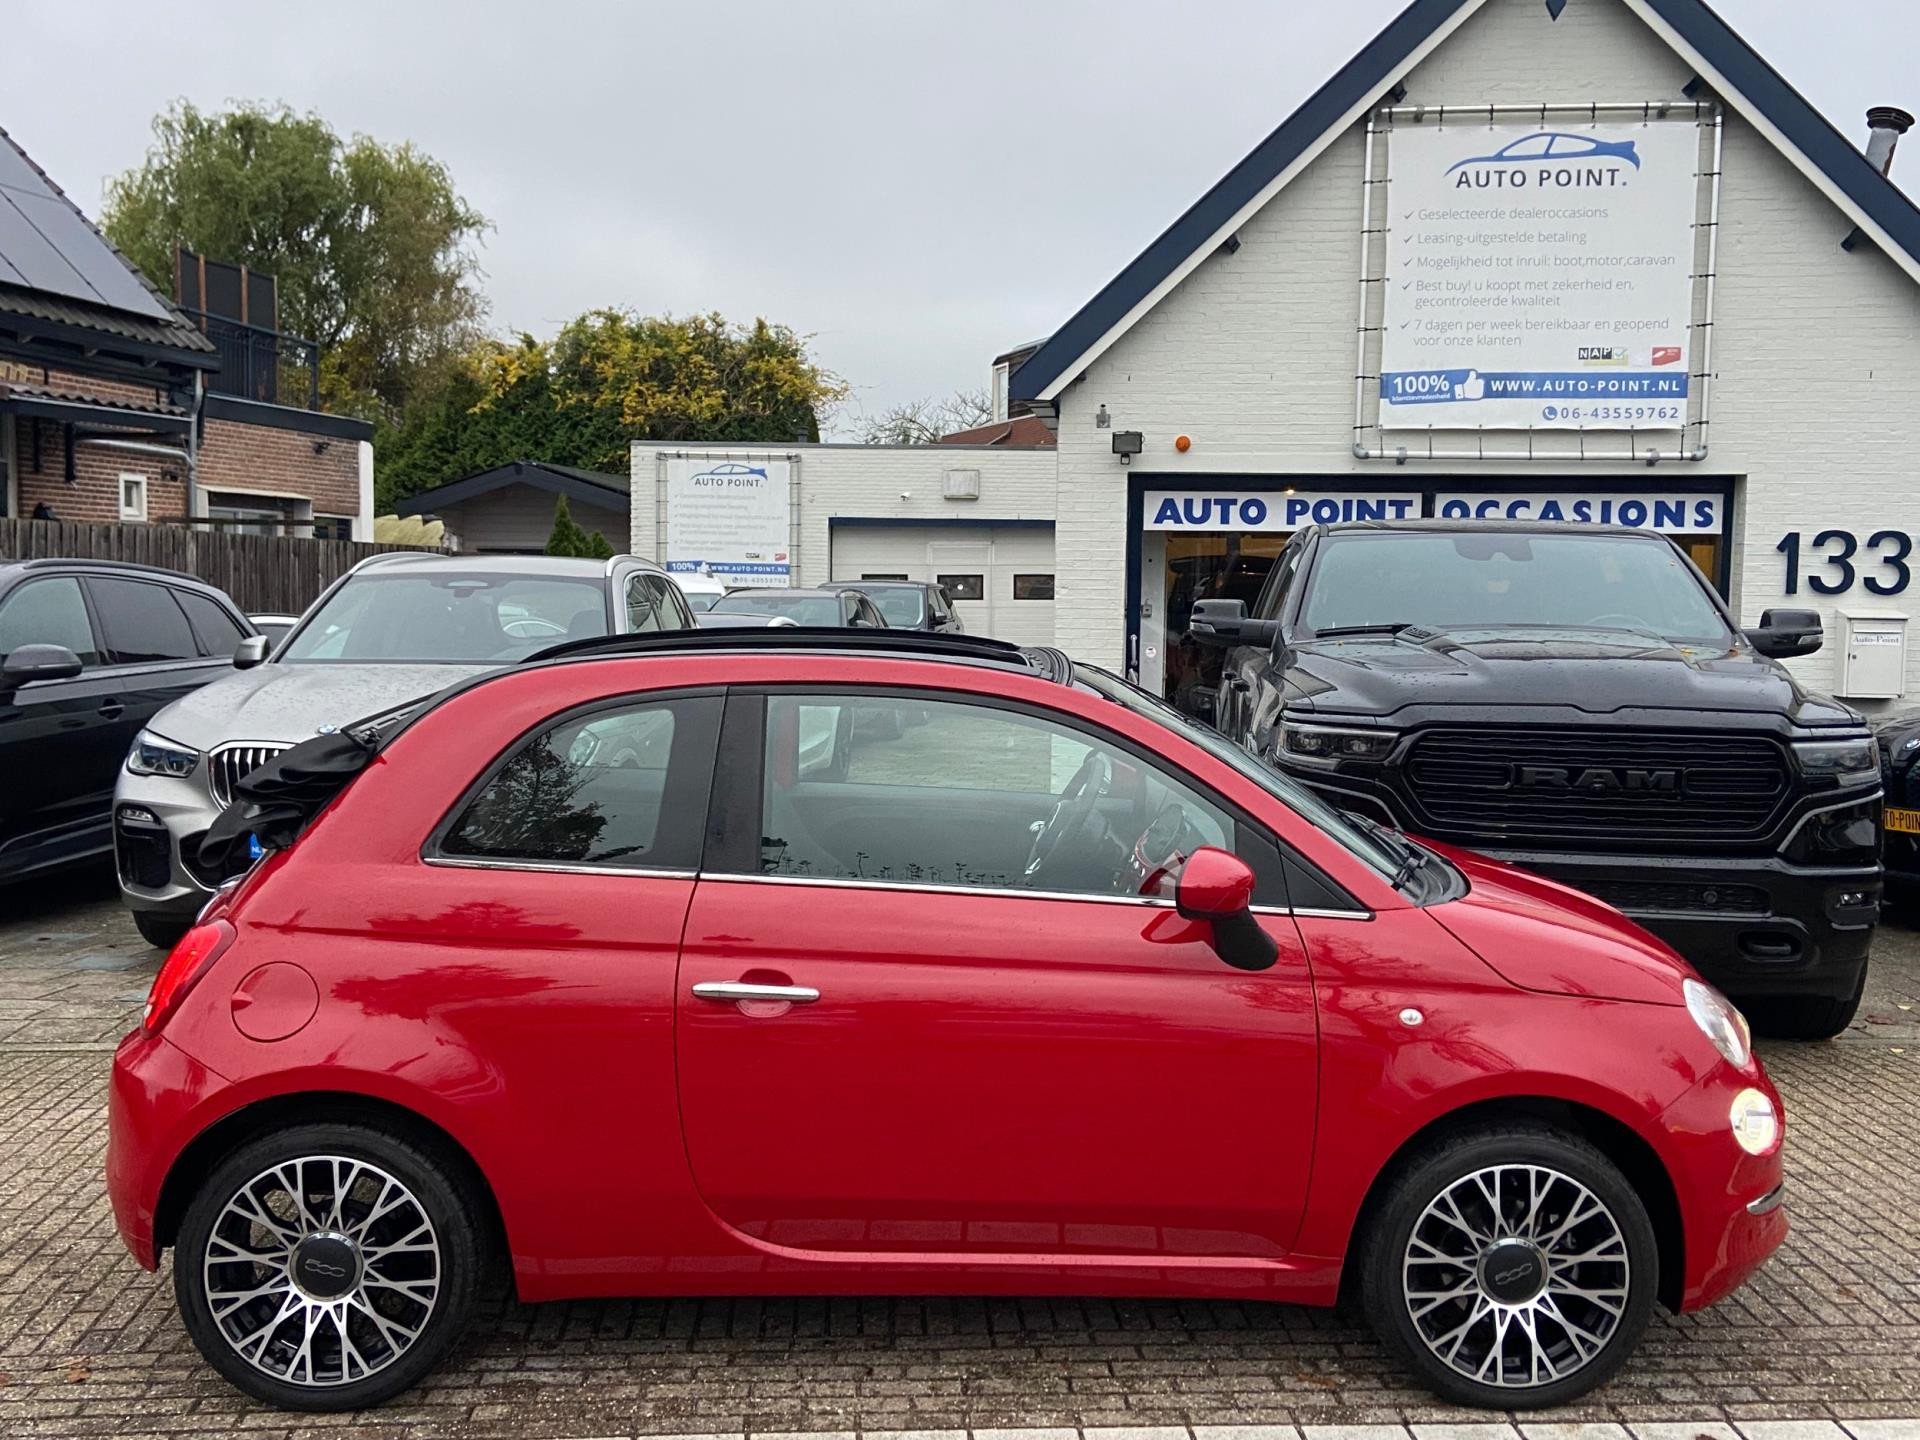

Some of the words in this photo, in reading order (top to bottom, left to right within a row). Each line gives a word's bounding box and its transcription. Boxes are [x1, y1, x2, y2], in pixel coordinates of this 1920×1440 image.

[1456, 170, 1527, 188] AUTO
[1418, 208, 1506, 221] Geselecteerde
[1509, 207, 1609, 220] dealeroccasions
[1417, 232, 1535, 246] Leasing-uitgestelde
[1538, 231, 1587, 246] betaling
[1416, 255, 1493, 270] Mogelijkheid
[1496, 256, 1513, 267] tot
[1516, 255, 1550, 267] inruil:
[1554, 255, 1676, 268] boot,motor,caravan
[1416, 280, 1442, 291] Best
[1474, 283, 1483, 291] u
[1486, 279, 1521, 293] koopt
[1524, 280, 1549, 291] met
[1552, 278, 1613, 290] zekerheid
[1415, 295, 1508, 310] gecontroleerde
[1511, 295, 1561, 307] kwaliteit
[1414, 320, 1422, 330] 7
[1425, 319, 1463, 334] dagen
[1466, 321, 1488, 332] per
[1490, 319, 1522, 330] week
[1525, 318, 1590, 330] bereikbaar
[1594, 320, 1610, 330] en
[1613, 318, 1669, 333] geopend
[1413, 337, 1442, 346] voor
[1444, 336, 1474, 346] onze
[1476, 334, 1522, 346] klanten
[1578, 347, 1612, 360] NAP
[1393, 374, 1450, 394] 100%
[1491, 379, 1680, 392] WWW.AUTO-POINT.NL
[1560, 407, 1679, 420] 06-43559762
[694, 478, 723, 487] AUTO
[1153, 498, 1267, 525] AUTO
[1286, 499, 1414, 525] POINT
[1442, 499, 1714, 528] OCCASIONS
[671, 562, 695, 571] 100%
[1776, 529, 1913, 595] 133
[1519, 767, 1676, 791] RAM
